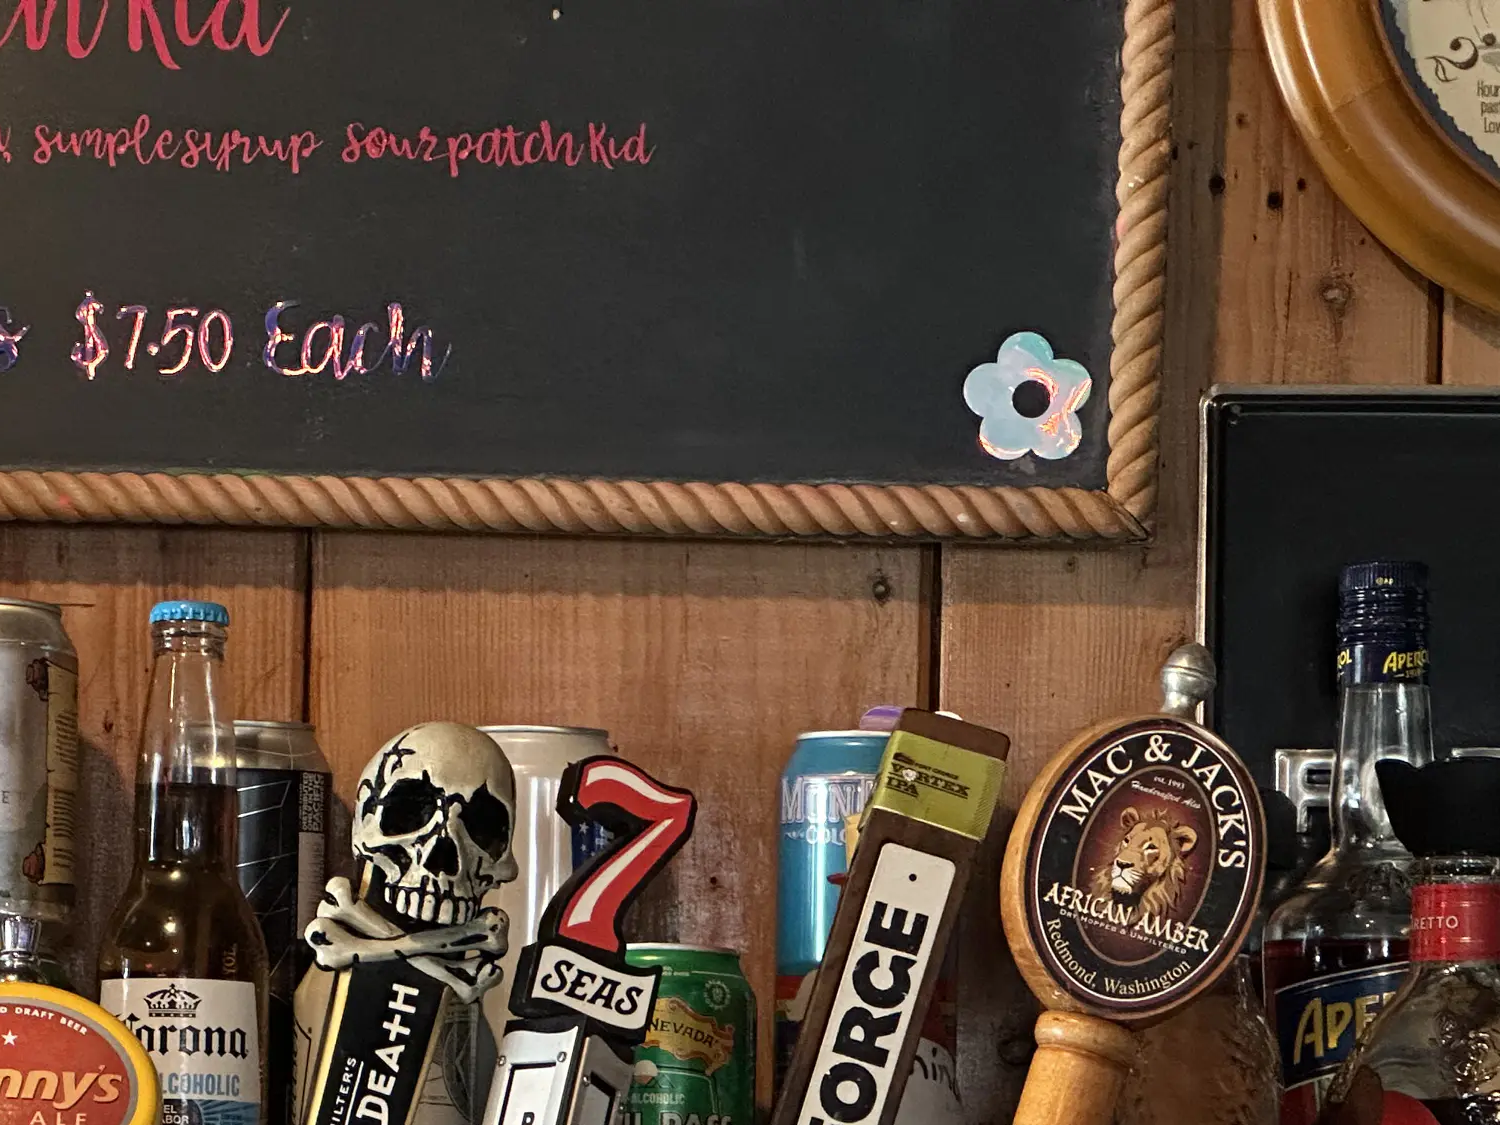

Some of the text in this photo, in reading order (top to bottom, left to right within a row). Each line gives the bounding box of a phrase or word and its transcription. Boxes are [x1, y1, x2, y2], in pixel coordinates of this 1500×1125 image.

[71, 290, 234, 380] $7.50
[263, 302, 452, 380] Each
[1, 790, 11, 804] E
[886, 775, 919, 796] IPA
[891, 762, 971, 797] VORTEX
[1130, 779, 1181, 803] Handcrafted
[1167, 777, 1185, 790] 1993
[1058, 733, 1247, 869] MAC & JACK'S
[558, 759, 694, 953] 7
[1042, 881, 1210, 953] AFRICAN AMBER
[1059, 908, 1078, 919] DRY
[1119, 927, 1127, 936] &
[1129, 930, 1188, 955] UNFILTERED
[1046, 917, 1191, 996] Redmond, Washington
[540, 959, 644, 1016] SEAS
[14, 1007, 54, 1021] DRAFT
[59, 1016, 88, 1036] BEER
[161, 1072, 241, 1098] LCOHOLIC
